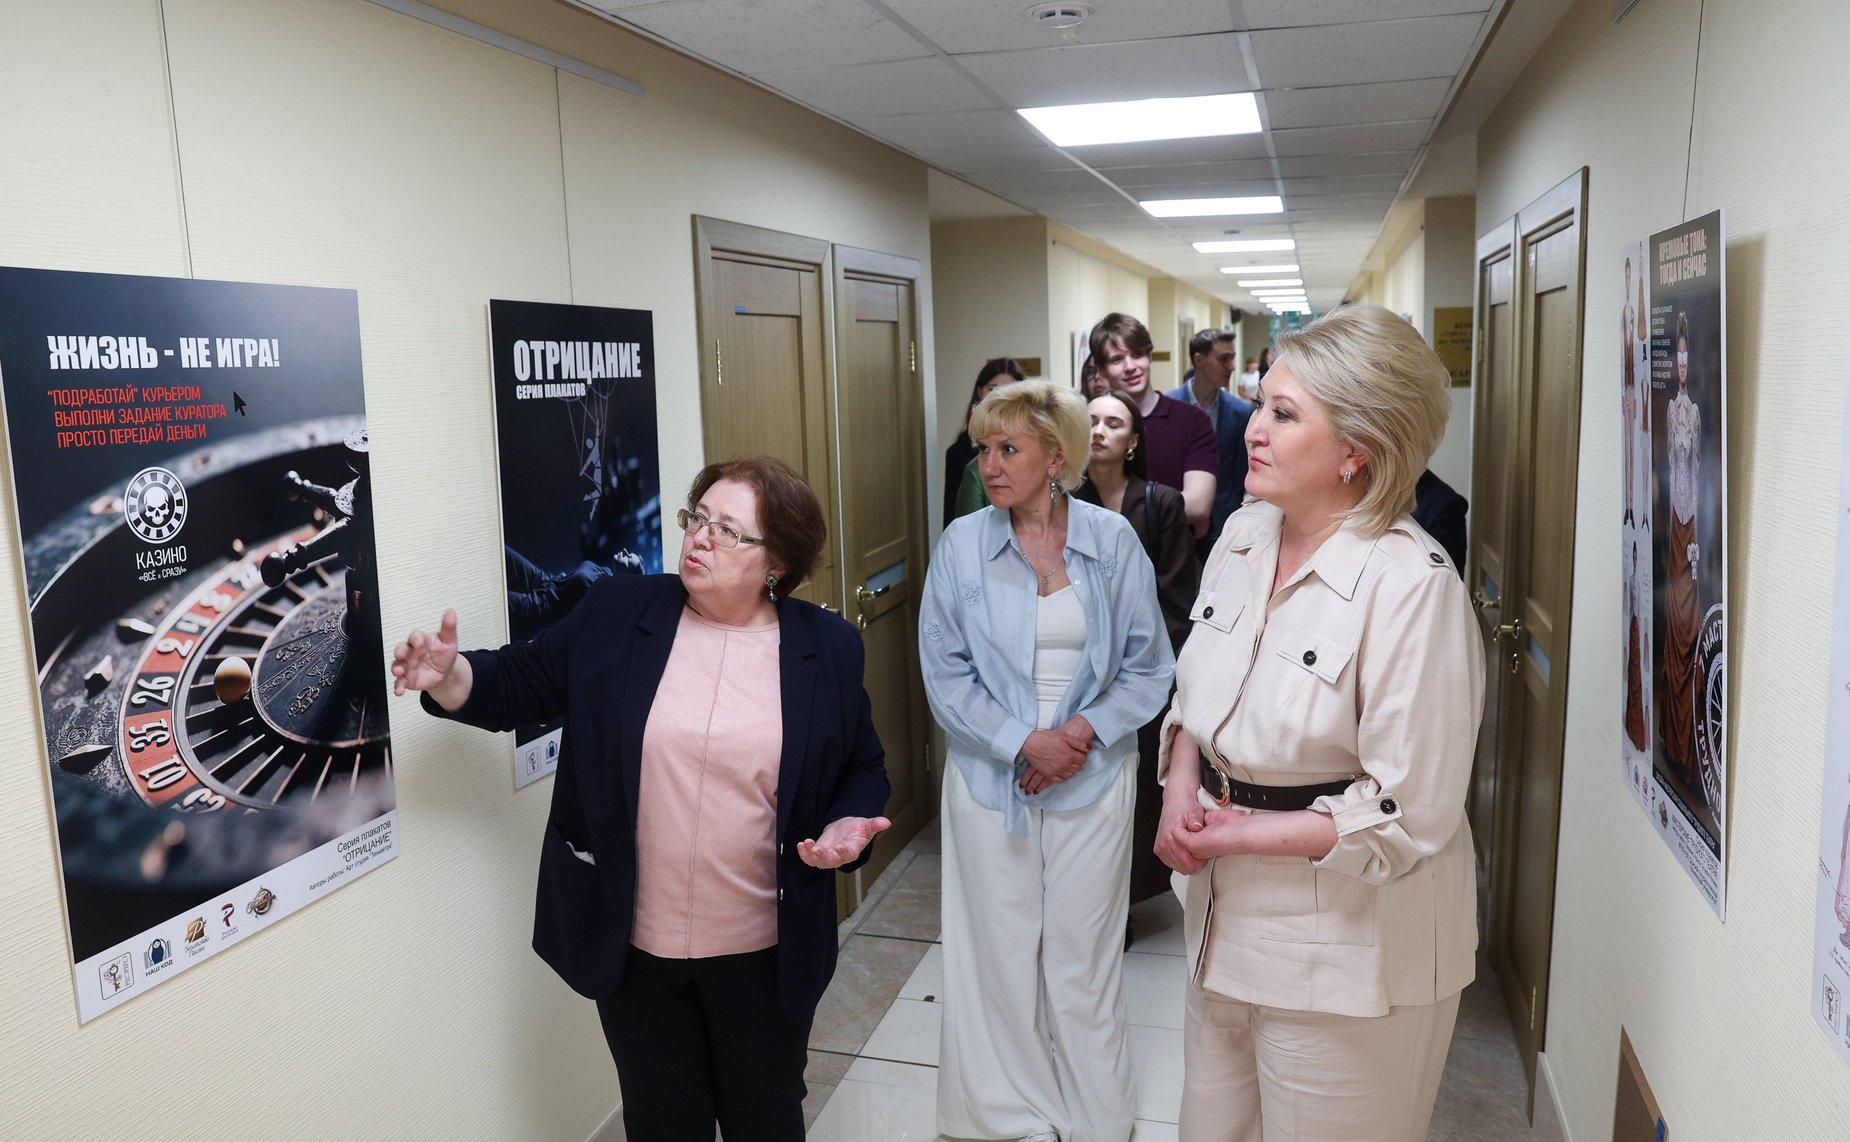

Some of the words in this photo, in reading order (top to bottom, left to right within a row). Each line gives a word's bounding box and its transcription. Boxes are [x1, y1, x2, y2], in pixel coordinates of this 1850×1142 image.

[1660, 261, 1677, 286] ТОГДА
[1678, 260, 1682, 281] И
[47, 335, 159, 370] ЖИЗНЬ
[179, 337, 212, 368] НЕ
[216, 338, 280, 368] ИГРА!
[513, 340, 642, 385] ОТРИЦАНИЕ
[142, 386, 201, 403] КУРЬЕРОМ
[516, 384, 544, 400] СЕРИЯ
[544, 382, 586, 399] ПЛАКАТОВ
[54, 410, 115, 427] ВЫПОЛНИ
[119, 407, 172, 424] ЗАДАНИЕ
[175, 404, 227, 421] КУРАТОРА
[57, 430, 107, 448] ПРОСТО
[109, 424, 164, 446] ПЕРЕДАЙ
[166, 424, 207, 442] ДЕНЬГИ
[136, 545, 187, 570] КАЗИНО
[131, 675, 175, 707] 26
[337, 835, 360, 853] Серия
[361, 820, 392, 842] плакатов
[309, 877, 327, 892] Авторы
[354, 856, 369, 868] студия
[145, 966, 161, 977] НАШ
[161, 959, 174, 970] КОД
